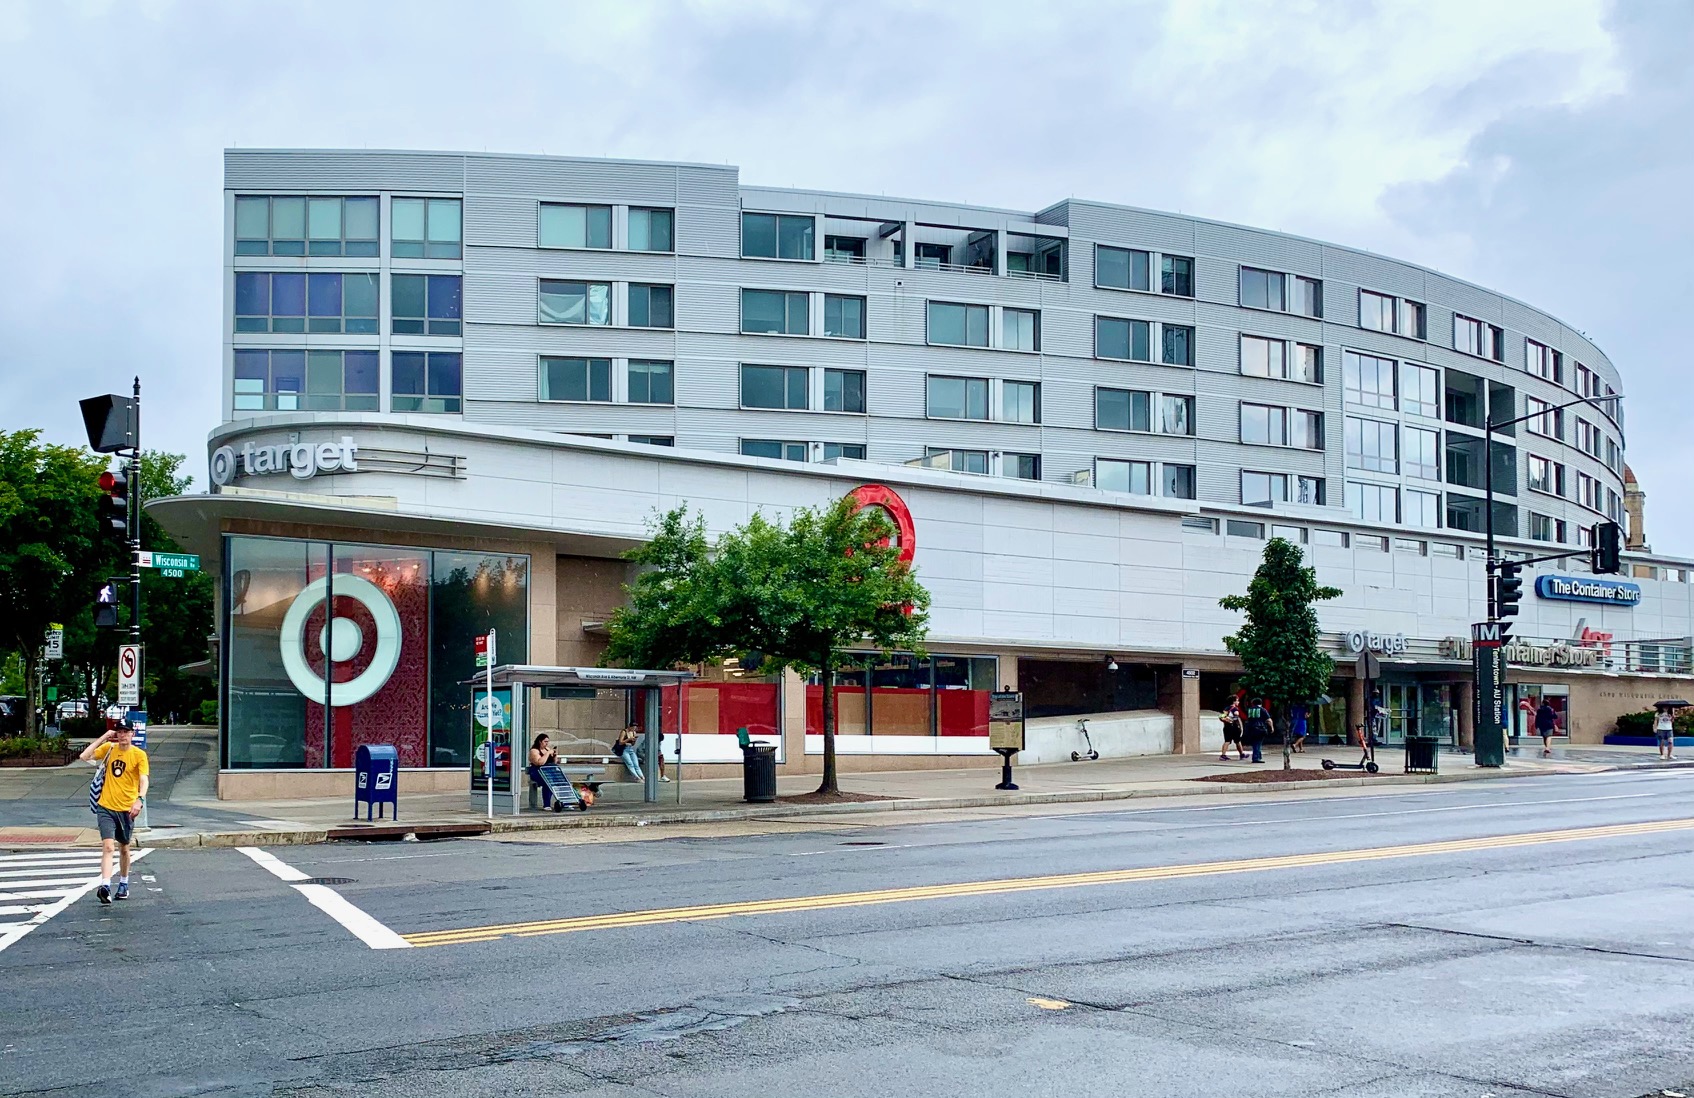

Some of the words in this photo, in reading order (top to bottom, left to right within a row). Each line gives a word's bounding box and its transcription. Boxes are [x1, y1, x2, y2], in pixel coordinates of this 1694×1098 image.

[241, 436, 358, 480] target
[155, 554, 188, 568] Wisconsin
[162, 568, 183, 578] 4500
[1553, 578, 1571, 595] The
[1572, 580, 1617, 600] Container
[1480, 624, 1500, 641] M
[48, 640, 60, 649] 15
[1367, 633, 1408, 655] target
[1492, 647, 1500, 686] Tenleytown
[1557, 644, 1597, 667] Store
[1493, 688, 1501, 699] AU
[1493, 700, 1502, 725] Station
